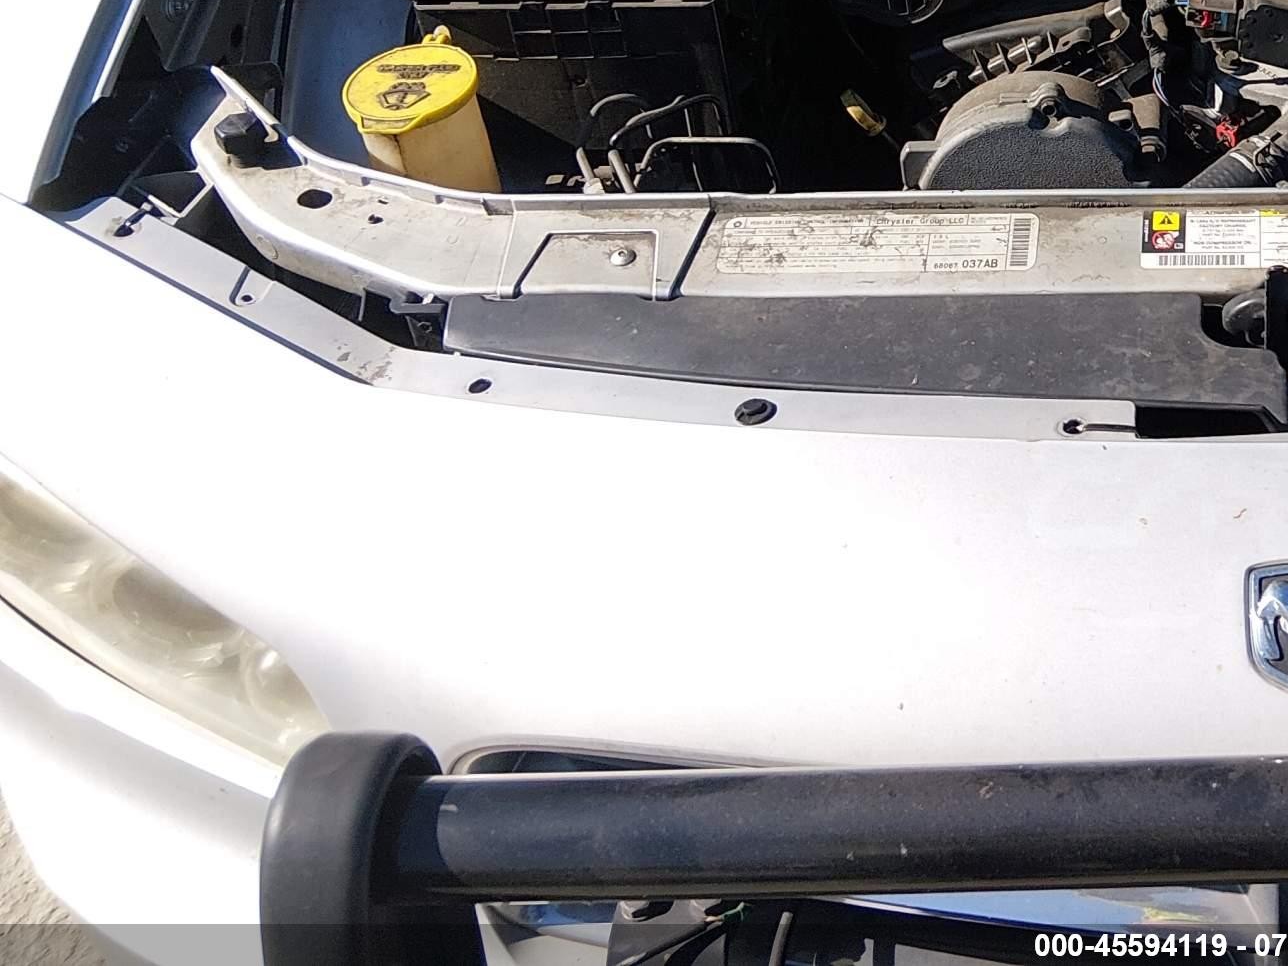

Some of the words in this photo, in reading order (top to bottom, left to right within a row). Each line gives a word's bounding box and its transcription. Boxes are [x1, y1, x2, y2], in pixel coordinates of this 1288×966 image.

[919, 217, 945, 227] Group
[948, 217, 965, 225] LLC
[961, 258, 999, 269] 037AB
